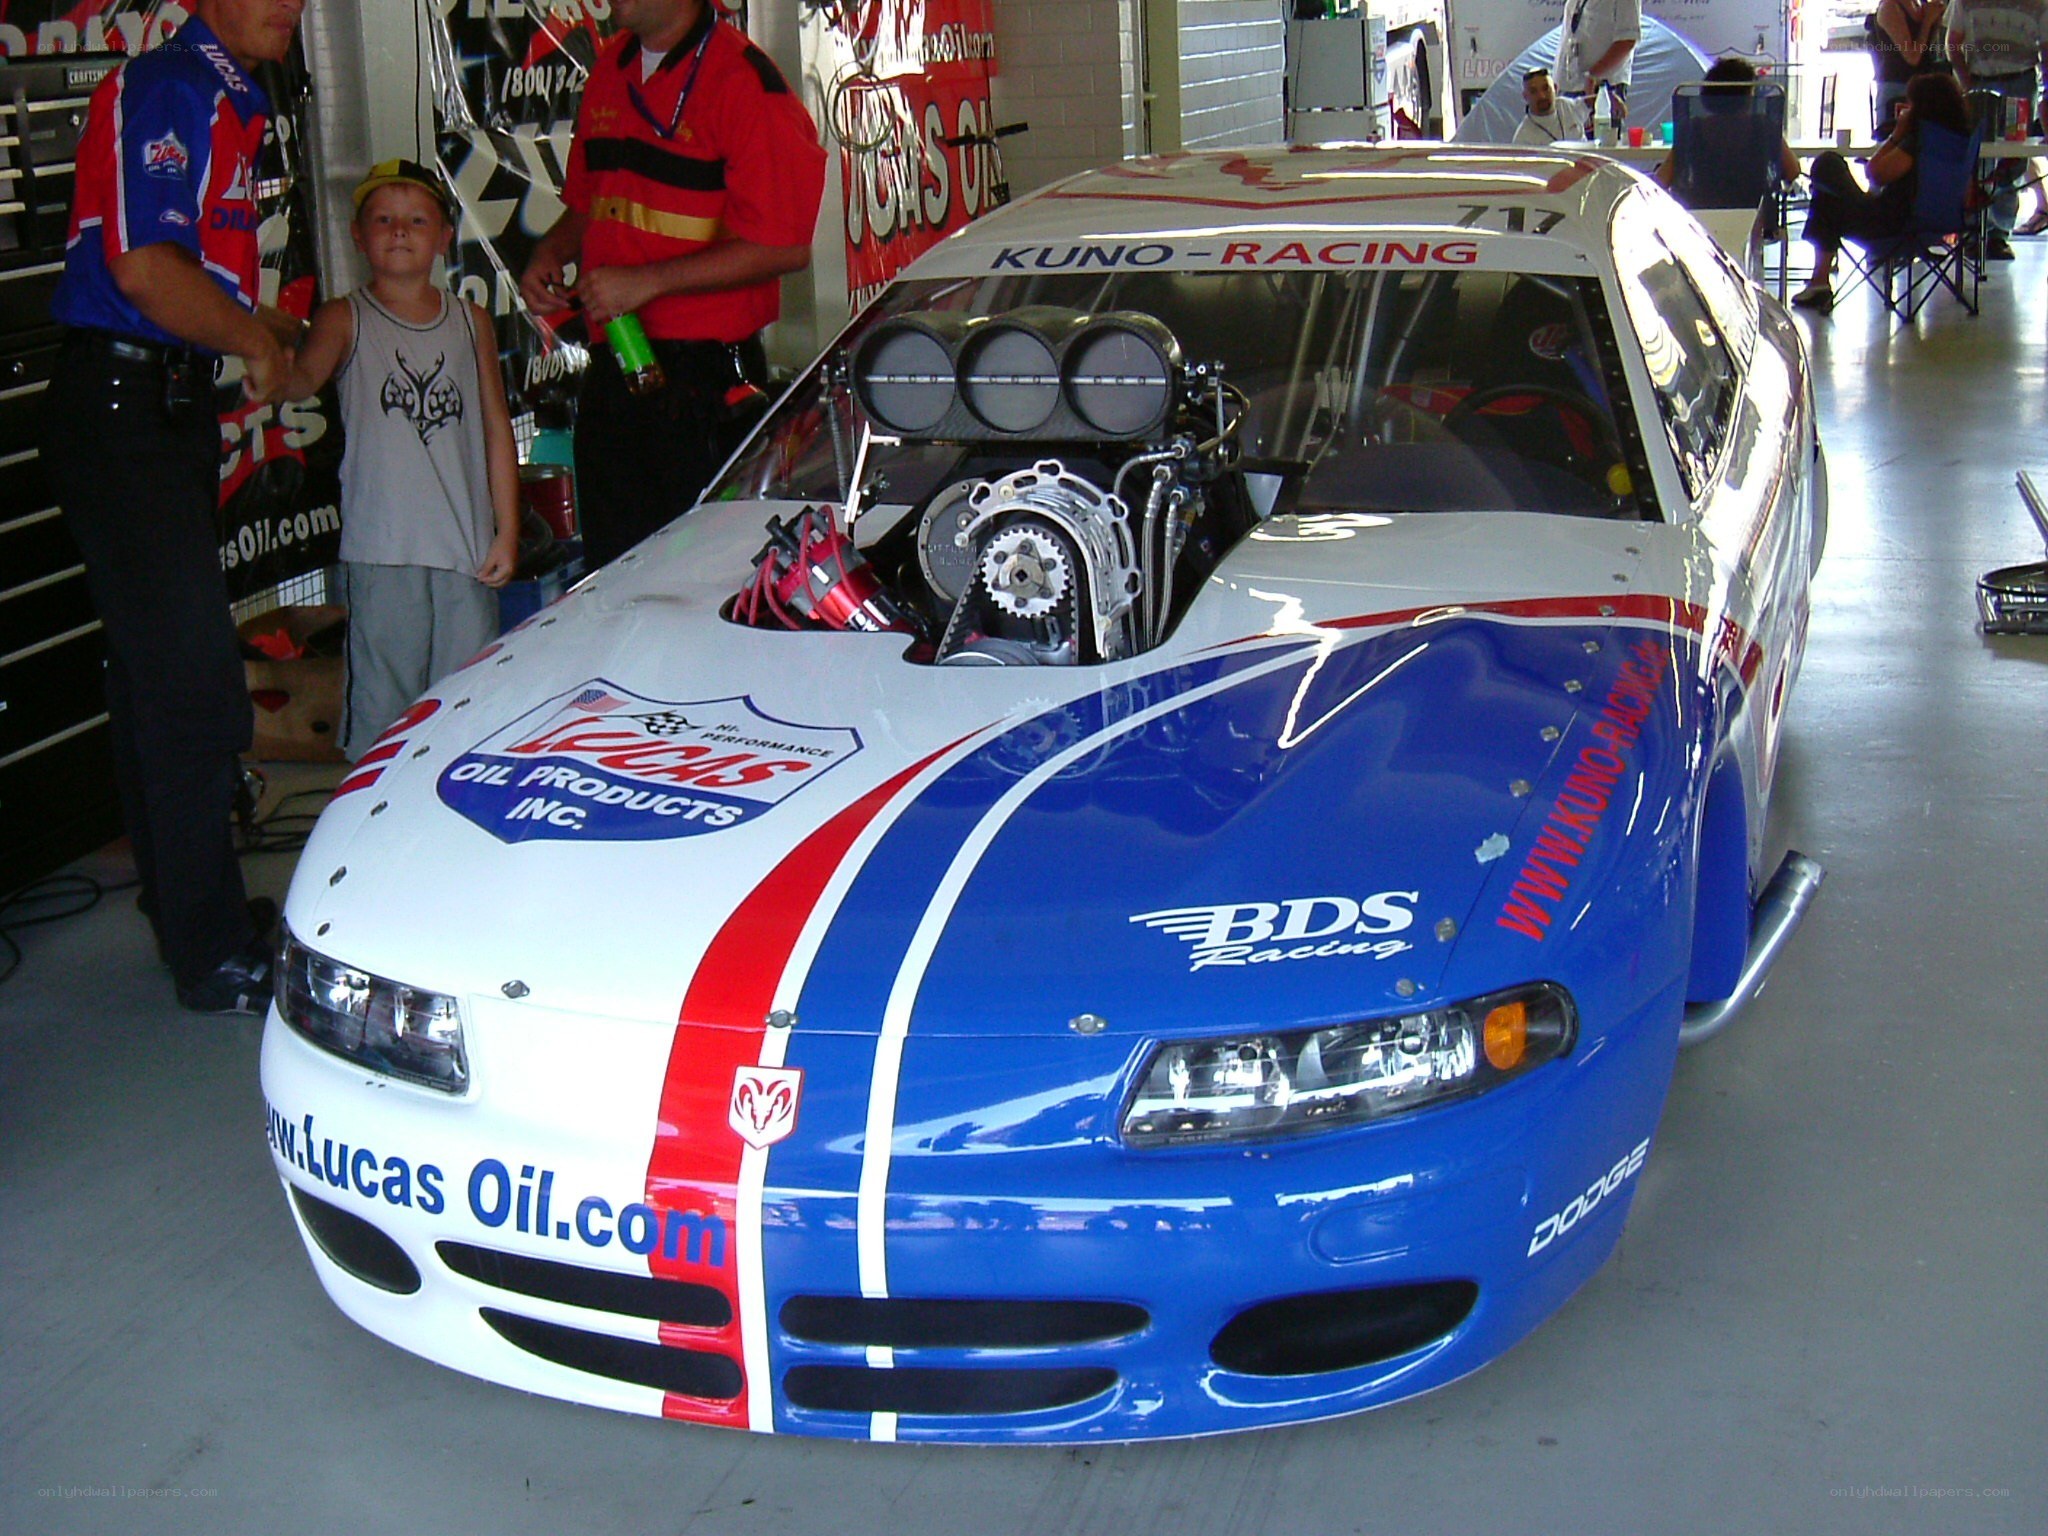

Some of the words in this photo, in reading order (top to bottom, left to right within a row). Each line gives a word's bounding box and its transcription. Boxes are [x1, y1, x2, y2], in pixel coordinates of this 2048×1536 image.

[1456, 204, 1566, 235] 717
[991, 244, 1173, 270] KUNO
[1219, 241, 1478, 265] RACING
[504, 715, 812, 788] LUCAS
[699, 731, 835, 759] PERFORMANCE
[449, 761, 510, 787] OIL
[518, 764, 744, 827] PRODUCTS
[504, 796, 588, 831] INC.
[1191, 890, 1420, 951] BDS
[1188, 940, 1414, 973] Racing
[467, 1157, 727, 1268] Oil.com
[1527, 1136, 1650, 1258] DODGE
